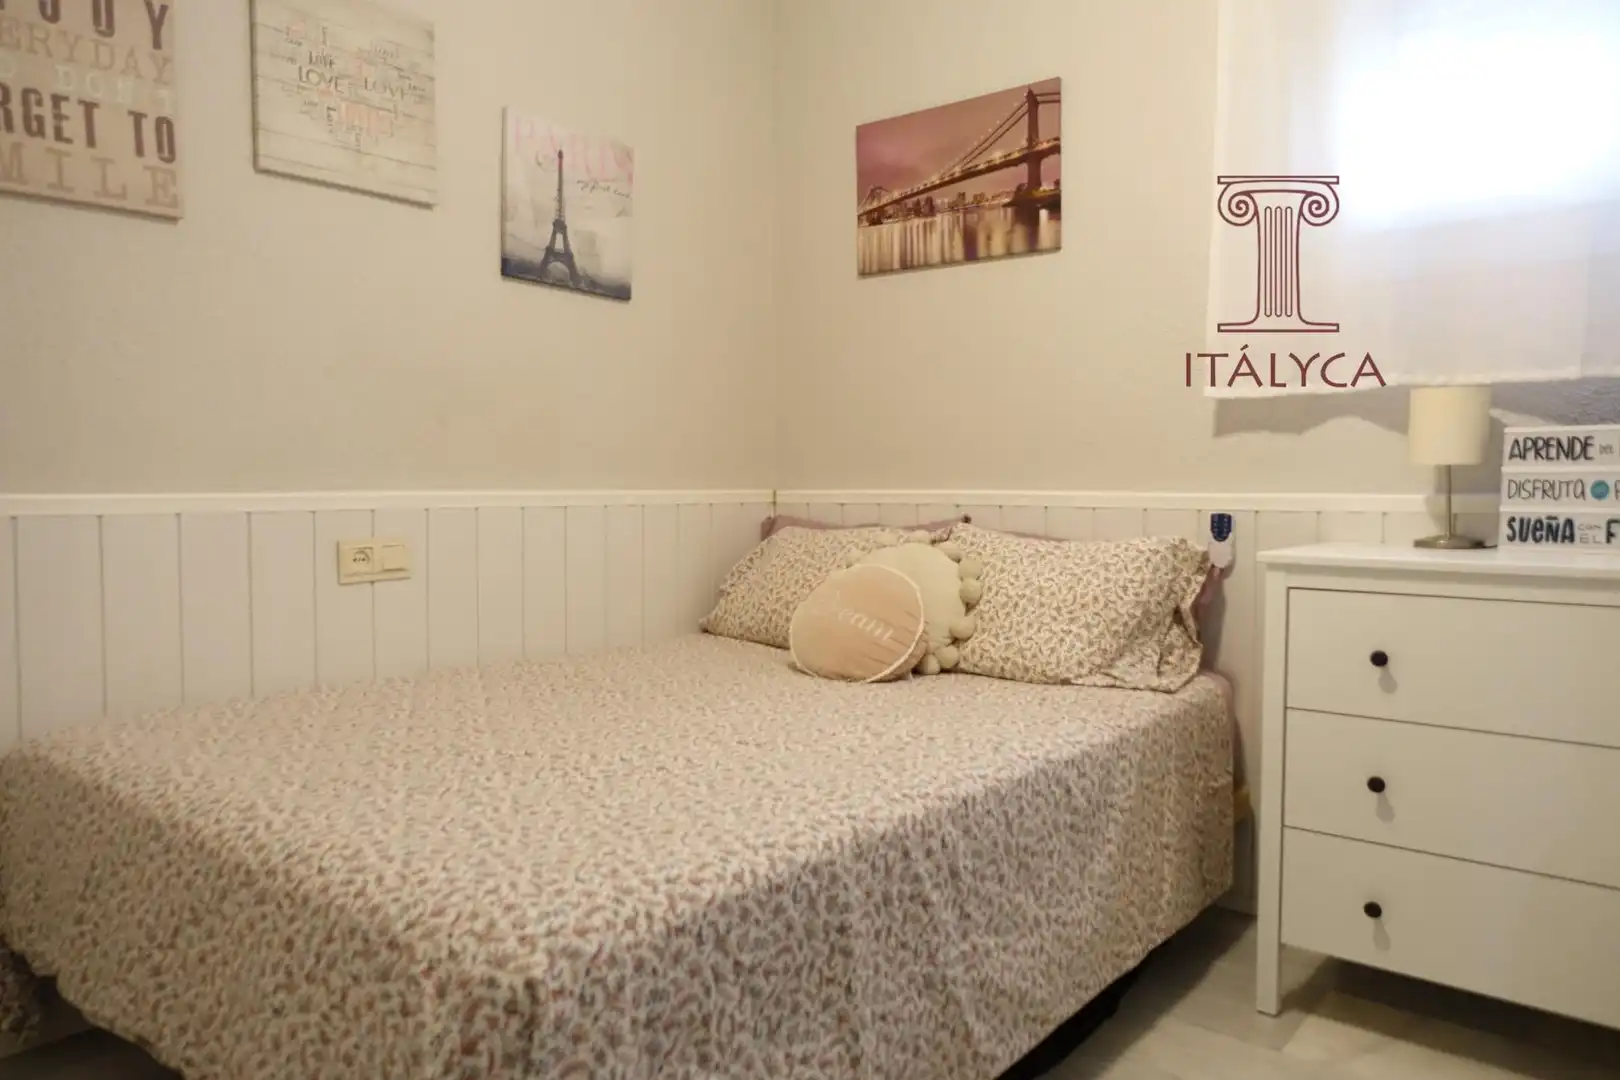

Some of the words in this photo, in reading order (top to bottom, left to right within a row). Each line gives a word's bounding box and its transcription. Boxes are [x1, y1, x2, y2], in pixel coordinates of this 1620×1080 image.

[0, 0, 169, 50] JOY
[127, 110, 176, 164] TO
[1508, 435, 1596, 460] APRENDE
[1507, 478, 1586, 501] DISFRUTA
